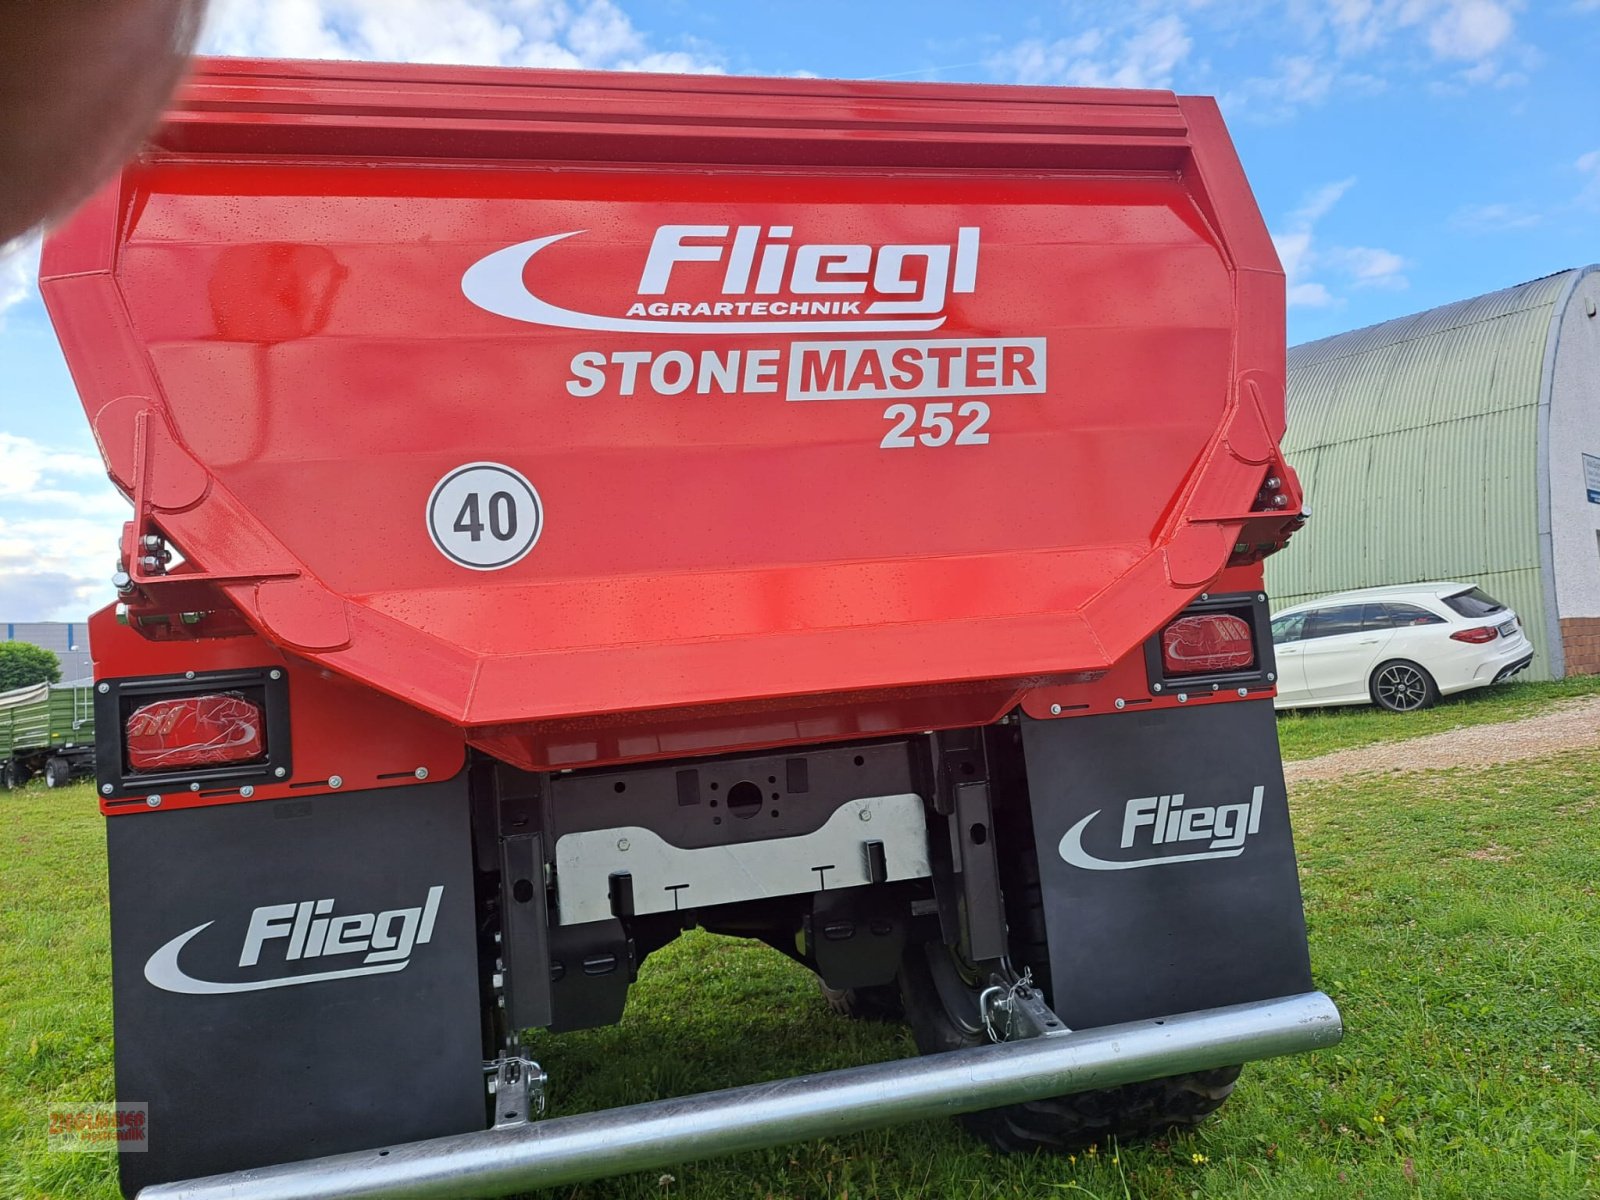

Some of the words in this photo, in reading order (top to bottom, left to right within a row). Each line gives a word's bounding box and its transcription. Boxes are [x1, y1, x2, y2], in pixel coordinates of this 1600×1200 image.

[637, 225, 980, 315] Fliegl
[626, 302, 860, 317] AGRARTECHNIK
[566, 350, 781, 397] STONE
[799, 346, 1037, 393] MASTER
[880, 401, 991, 448] 252
[453, 491, 517, 542] 40
[1120, 785, 1265, 849] Fliegl
[238, 885, 444, 967] Fliegl
